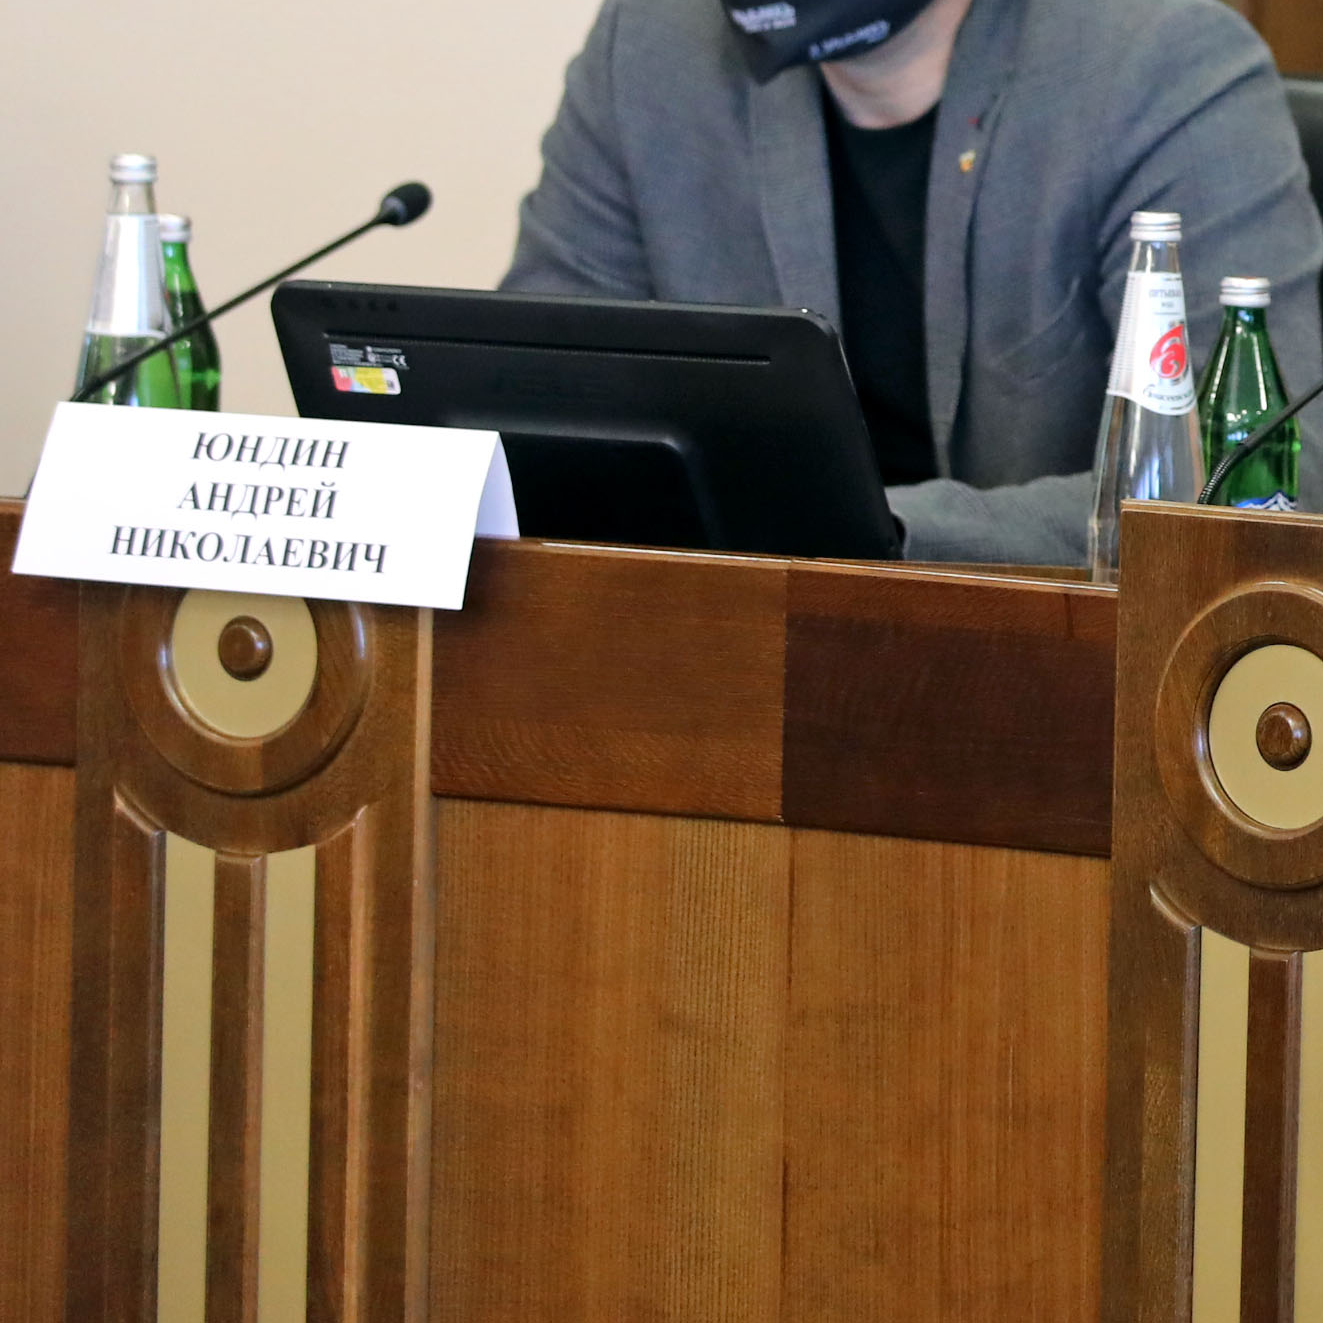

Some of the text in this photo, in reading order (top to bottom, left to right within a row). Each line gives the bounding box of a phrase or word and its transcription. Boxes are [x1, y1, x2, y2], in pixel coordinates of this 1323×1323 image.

[192, 432, 349, 469] ЮНДИН
[178, 482, 338, 520] АНДРЕЙ
[110, 526, 387, 573] НИКОЛАЕВИЧ
